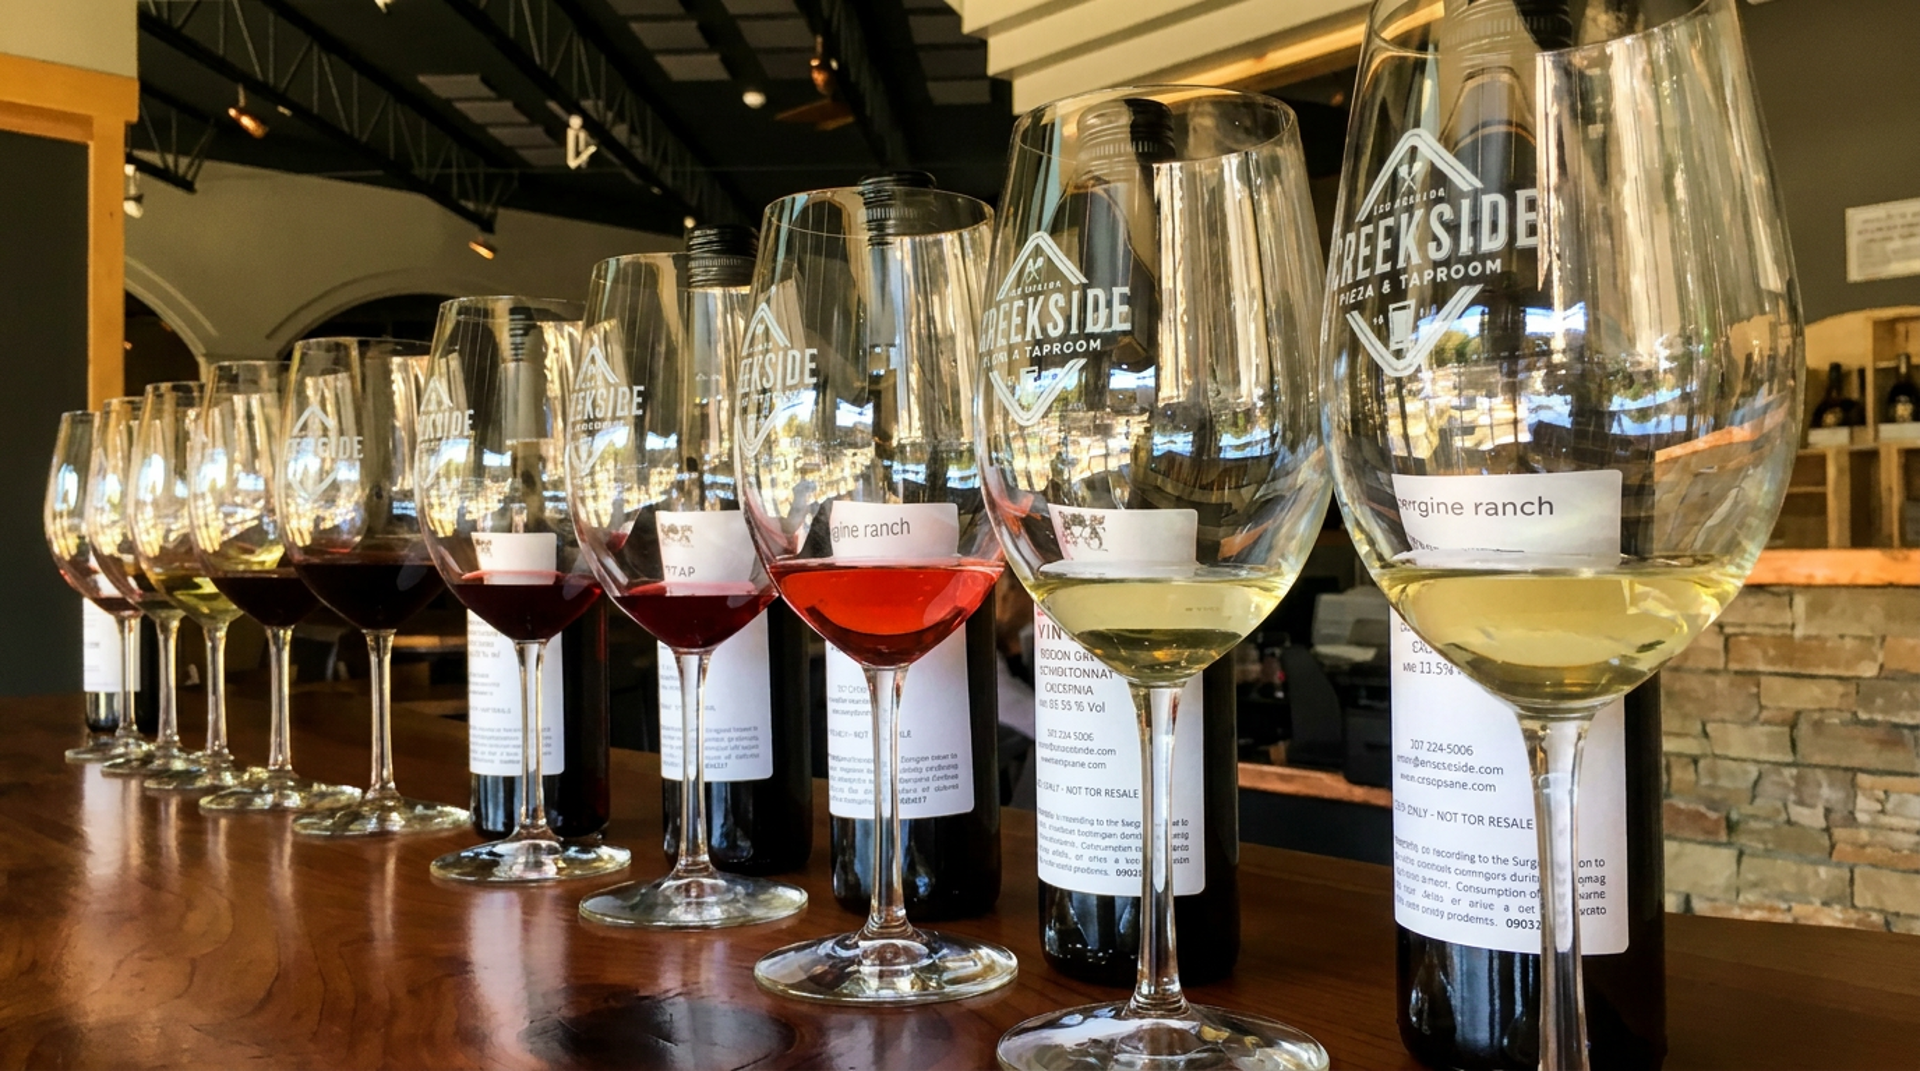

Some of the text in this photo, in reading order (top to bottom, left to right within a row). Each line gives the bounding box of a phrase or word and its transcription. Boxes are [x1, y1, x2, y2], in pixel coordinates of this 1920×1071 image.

[1399, 258, 1502, 290] TAPROOM
[1024, 338, 1102, 359] TAPROOM
[1474, 496, 1554, 517] ranch
[864, 517, 911, 538] ranch
[1426, 741, 1474, 756] 224-5006
[1104, 789, 1139, 799] RESALE
[1436, 810, 1459, 823] NOT
[1462, 813, 1485, 826] TOR
[1488, 816, 1534, 830] RESALE
[1478, 853, 1490, 864] to
[1491, 854, 1510, 866] the
[1512, 856, 1540, 871] Surg
[1594, 858, 1606, 868] to
[1455, 880, 1526, 900] Consumption
